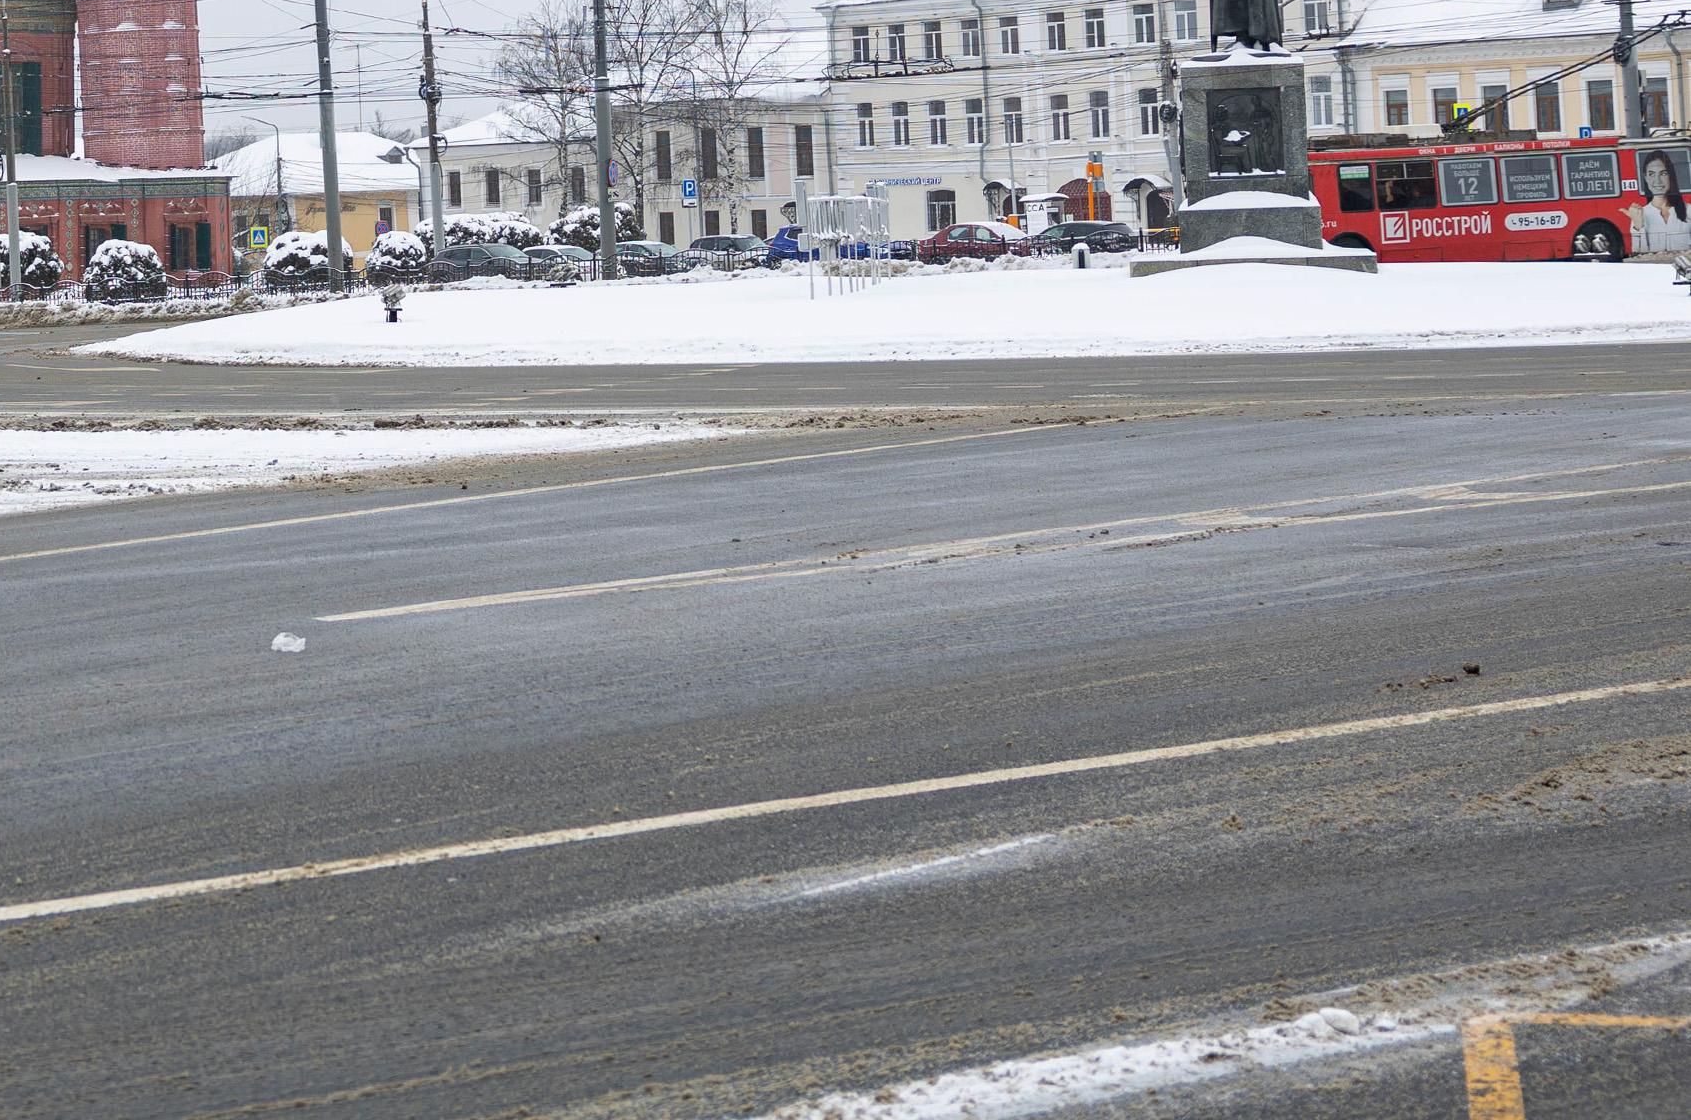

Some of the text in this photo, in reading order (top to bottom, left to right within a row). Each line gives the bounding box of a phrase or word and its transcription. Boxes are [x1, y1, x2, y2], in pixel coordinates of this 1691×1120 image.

[1579, 160, 1600, 170] ДАЁМ
[1509, 174, 1551, 182] ИСПОЛЬЗУЕМ
[1570, 169, 1610, 179] ГАРАНТИЮ
[1458, 177, 1479, 195] 12
[1570, 180, 1613, 192] 10 ЛЕТ!
[1412, 211, 1492, 238] РОССТРОЙ
[1518, 215, 1562, 226] 95-16-87
